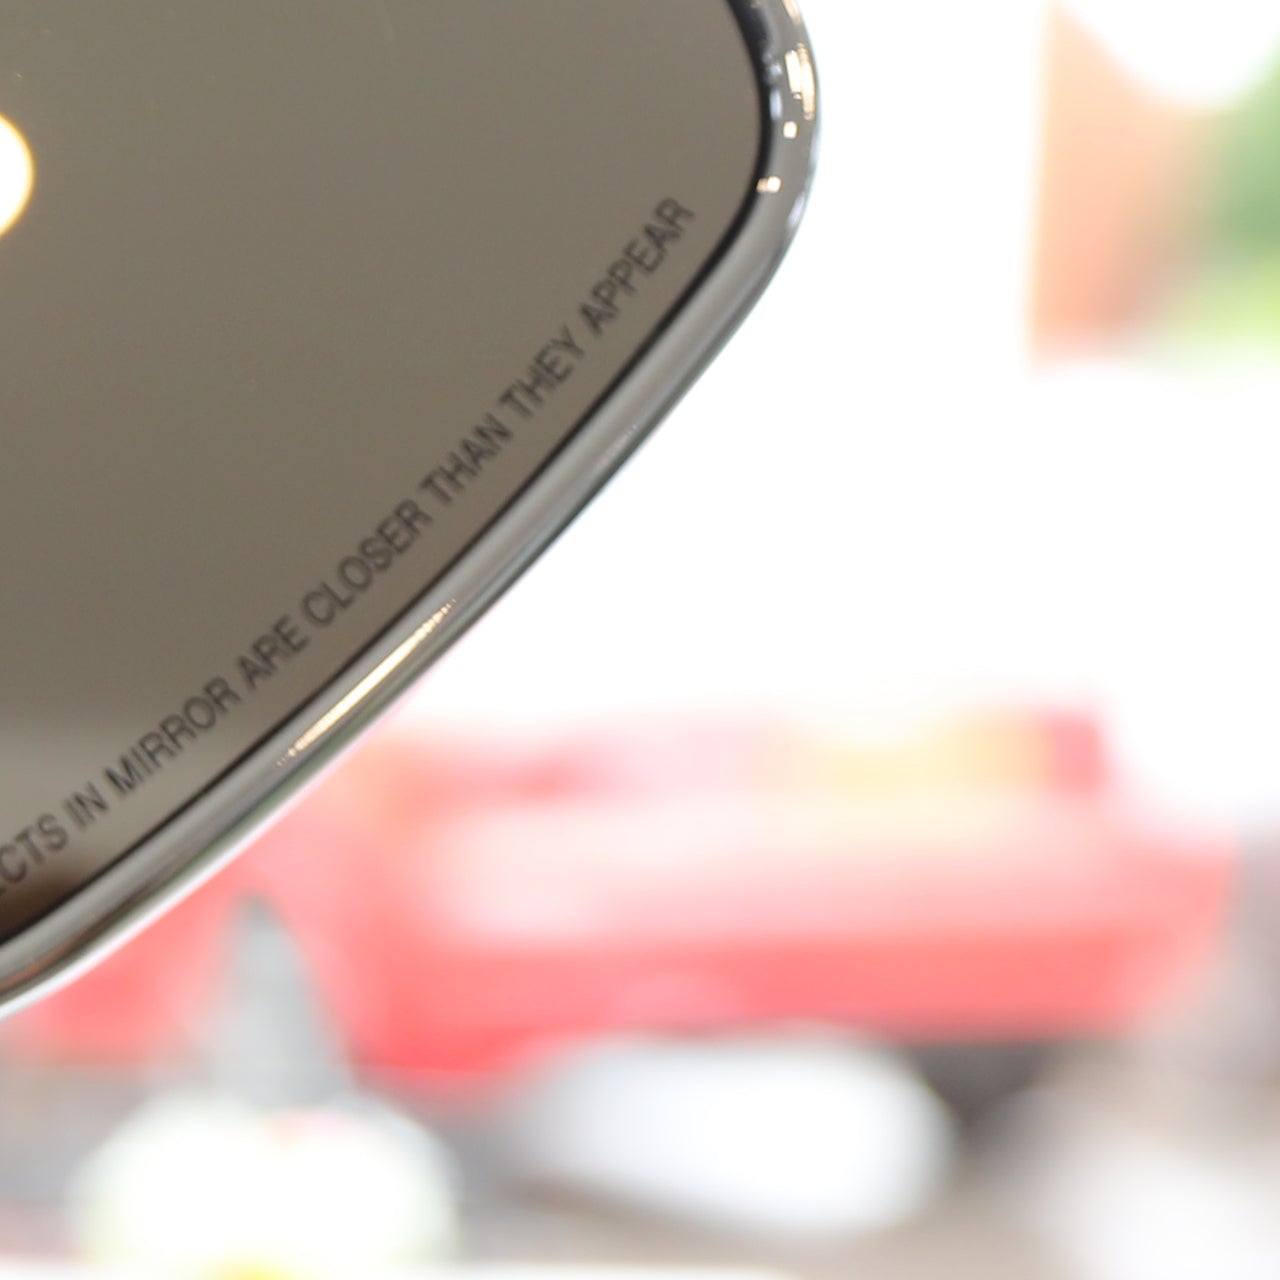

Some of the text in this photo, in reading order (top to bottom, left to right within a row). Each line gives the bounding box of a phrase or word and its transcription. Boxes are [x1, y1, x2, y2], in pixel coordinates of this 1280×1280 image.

[64, 781, 110, 831] IN
[104, 676, 242, 795] MIRROR
[237, 614, 309, 691] ARE
[302, 499, 433, 626] CLOSER
[419, 413, 513, 505] THAN
[499, 325, 584, 420] THEY
[579, 197, 695, 335] APPEAR
